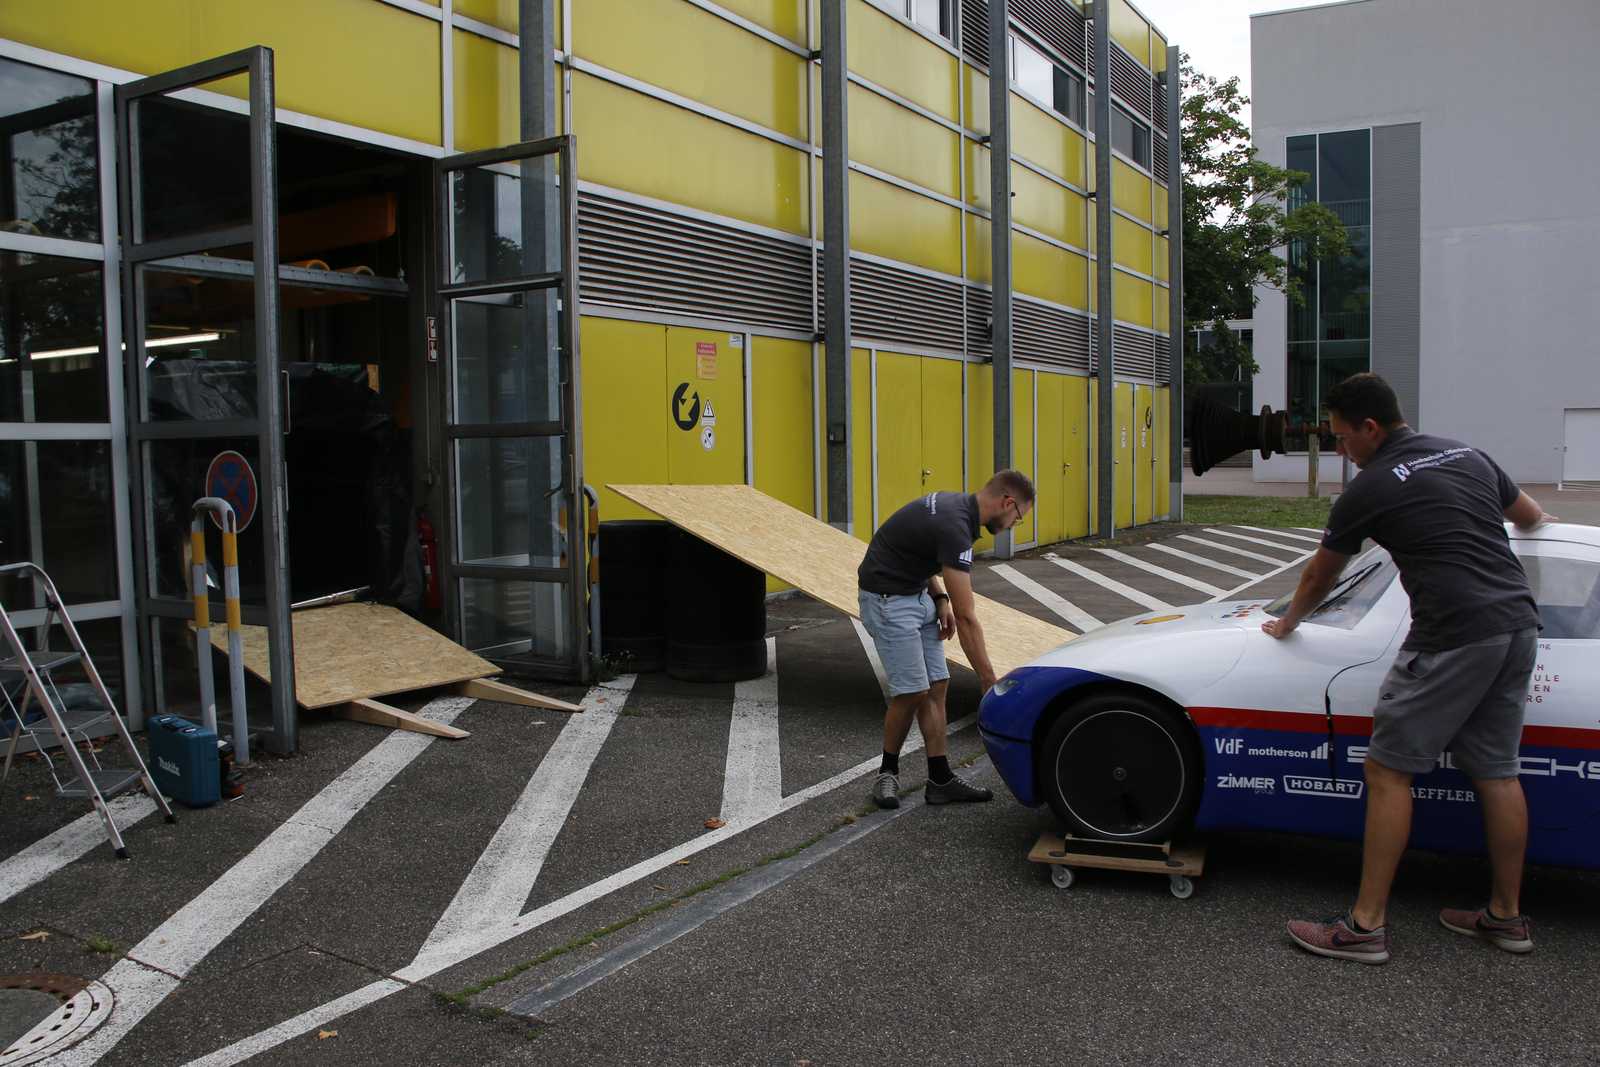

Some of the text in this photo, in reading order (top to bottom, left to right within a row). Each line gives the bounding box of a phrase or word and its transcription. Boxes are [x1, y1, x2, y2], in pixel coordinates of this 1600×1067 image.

[1537, 643, 1551, 651] ng
[1534, 674, 1560, 682] ULE
[1214, 737, 1244, 755] VdF
[1247, 746, 1309, 759] motherson
[1291, 779, 1356, 793] HOBART
[1410, 787, 1475, 802] AEFFLER
